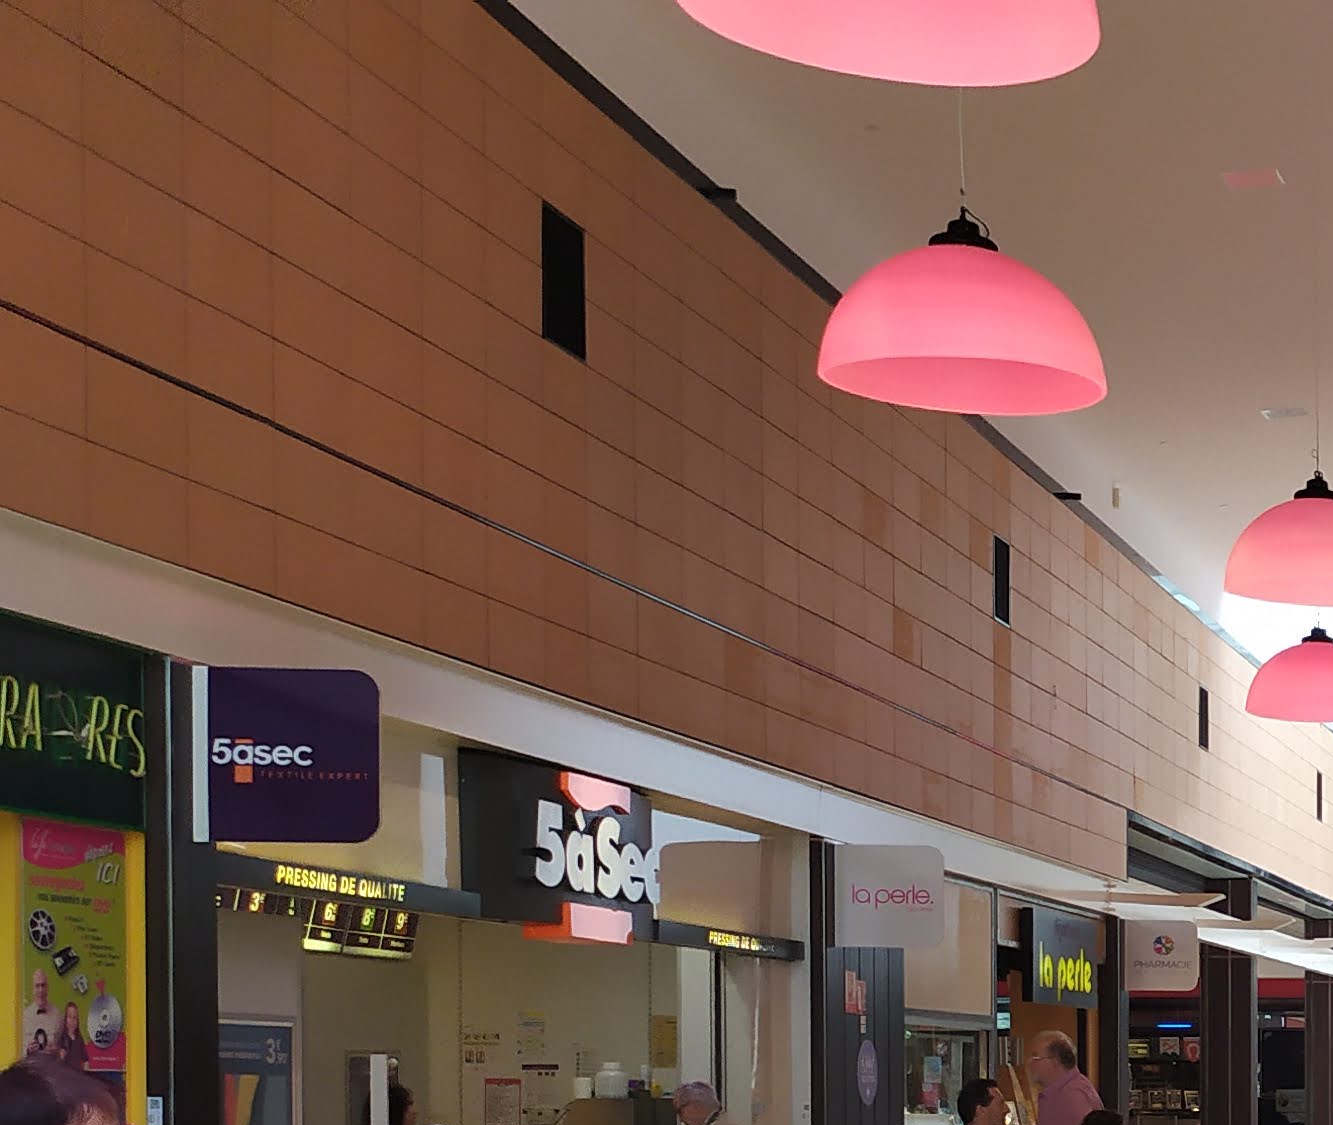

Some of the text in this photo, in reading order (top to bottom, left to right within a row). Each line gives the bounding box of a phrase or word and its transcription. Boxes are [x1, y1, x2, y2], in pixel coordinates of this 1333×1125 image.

[319, 771, 369, 782] EXPERT
[275, 864, 406, 902] PRESSING DE QUALITE
[851, 882, 871, 904] la
[1039, 940, 1092, 1003] la perle
[1133, 960, 1193, 969] PHARMACIE
